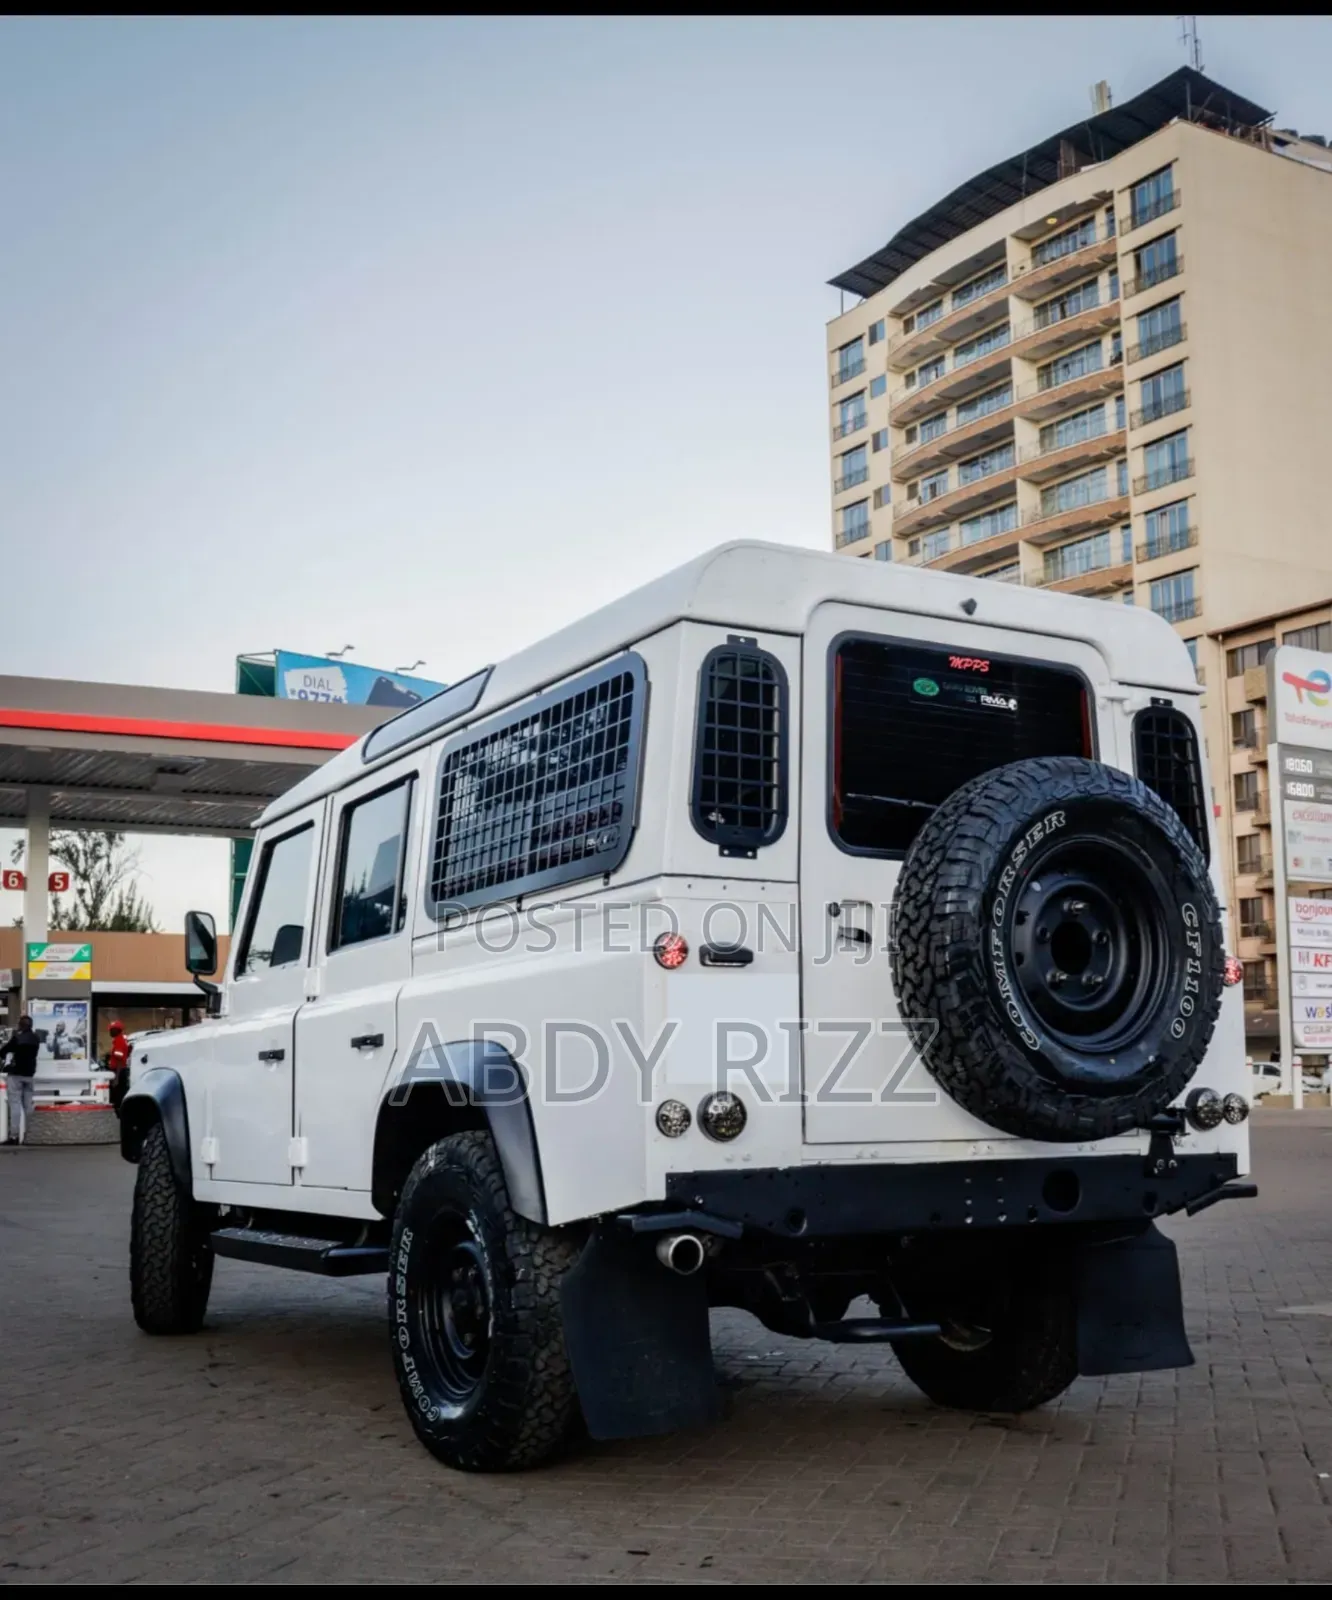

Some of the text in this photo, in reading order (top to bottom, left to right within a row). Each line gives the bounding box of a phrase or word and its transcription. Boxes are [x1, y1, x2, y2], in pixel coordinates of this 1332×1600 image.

[303, 675, 332, 691] DIAL
[8, 872, 19, 888] 6
[54, 874, 64, 890] 5
[1295, 902, 1332, 918] bonjou
[992, 810, 1067, 1051] COMFORSER
[1313, 952, 1332, 968] KF
[1171, 902, 1202, 1039] CF1100
[396, 1227, 441, 1422] COMFORSER
